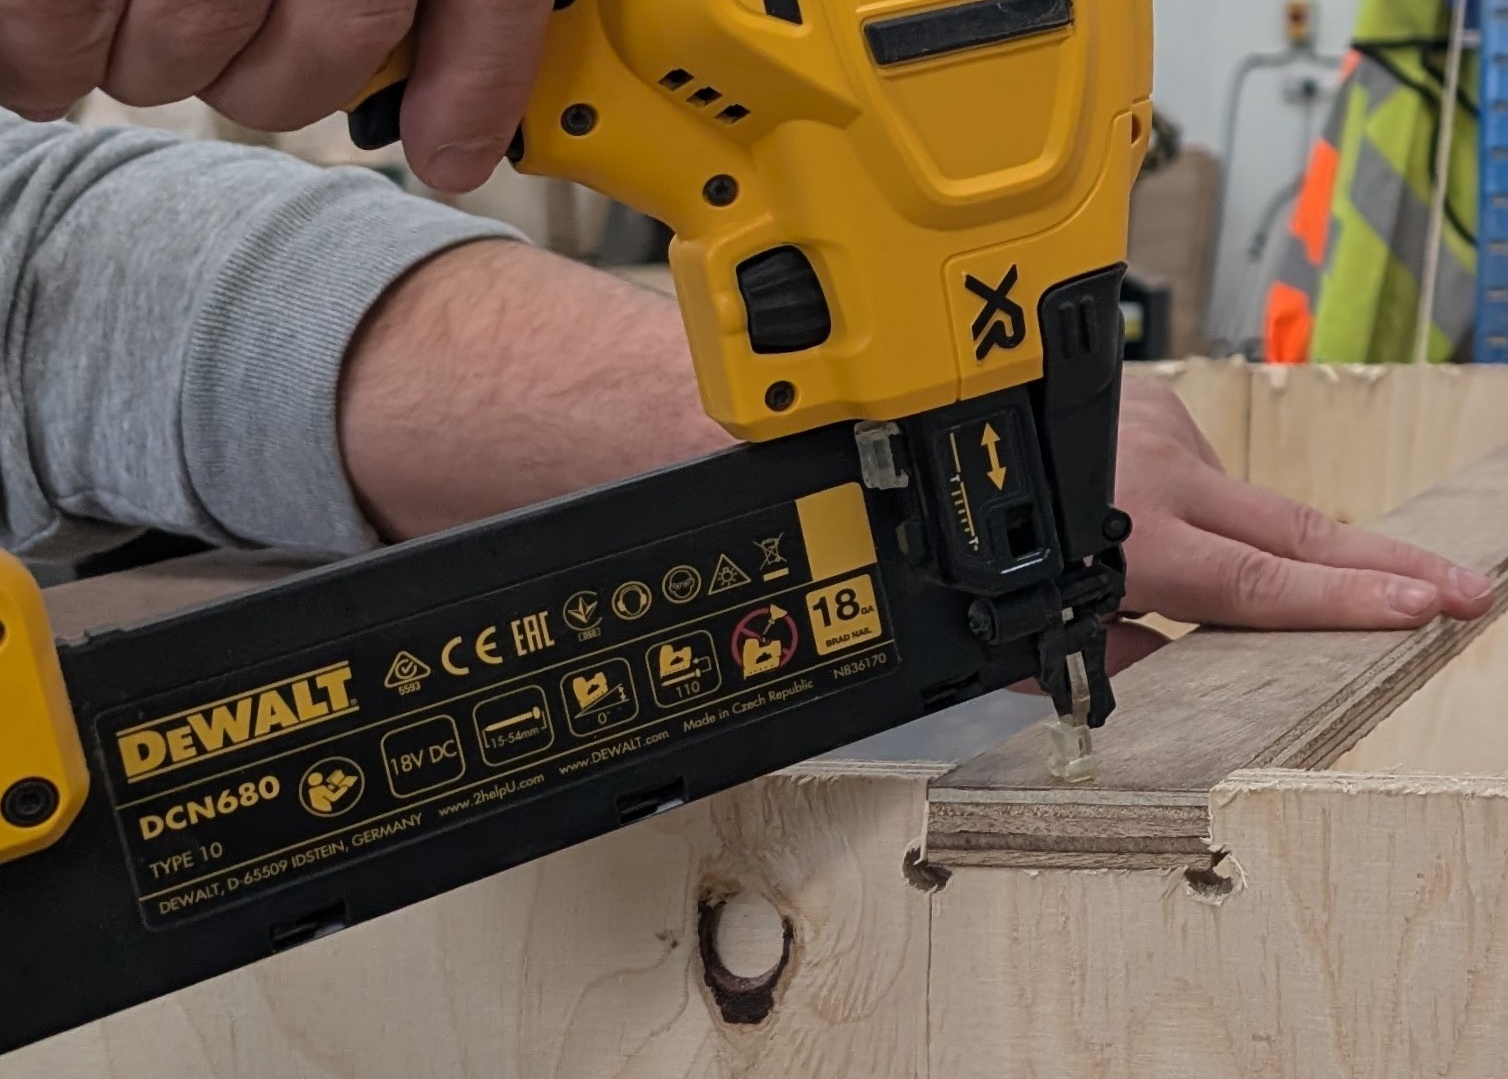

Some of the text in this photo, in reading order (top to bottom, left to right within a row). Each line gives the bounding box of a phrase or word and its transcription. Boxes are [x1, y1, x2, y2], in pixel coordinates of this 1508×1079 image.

[965, 264, 1026, 361] XR
[825, 627, 872, 648] BRAD NAIL
[676, 681, 700, 698] 110
[118, 667, 352, 778] DEWALT
[492, 726, 540, 749] 15-54mm
[391, 739, 457, 776] 18V DC
[139, 775, 280, 840] DCN680
[159, 884, 225, 915] DEWALT,
[291, 840, 349, 868] IDSTEIN,
[352, 812, 422, 847] GERMANY
[438, 773, 545, 817] www.2helpU.com
[559, 729, 669, 775] www.DEWALT.com
[683, 713, 716, 733] Made
[719, 707, 730, 720] in
[732, 694, 766, 715] Czech
[768, 679, 814, 703] Republic
[149, 841, 223, 879] TYPE 10
